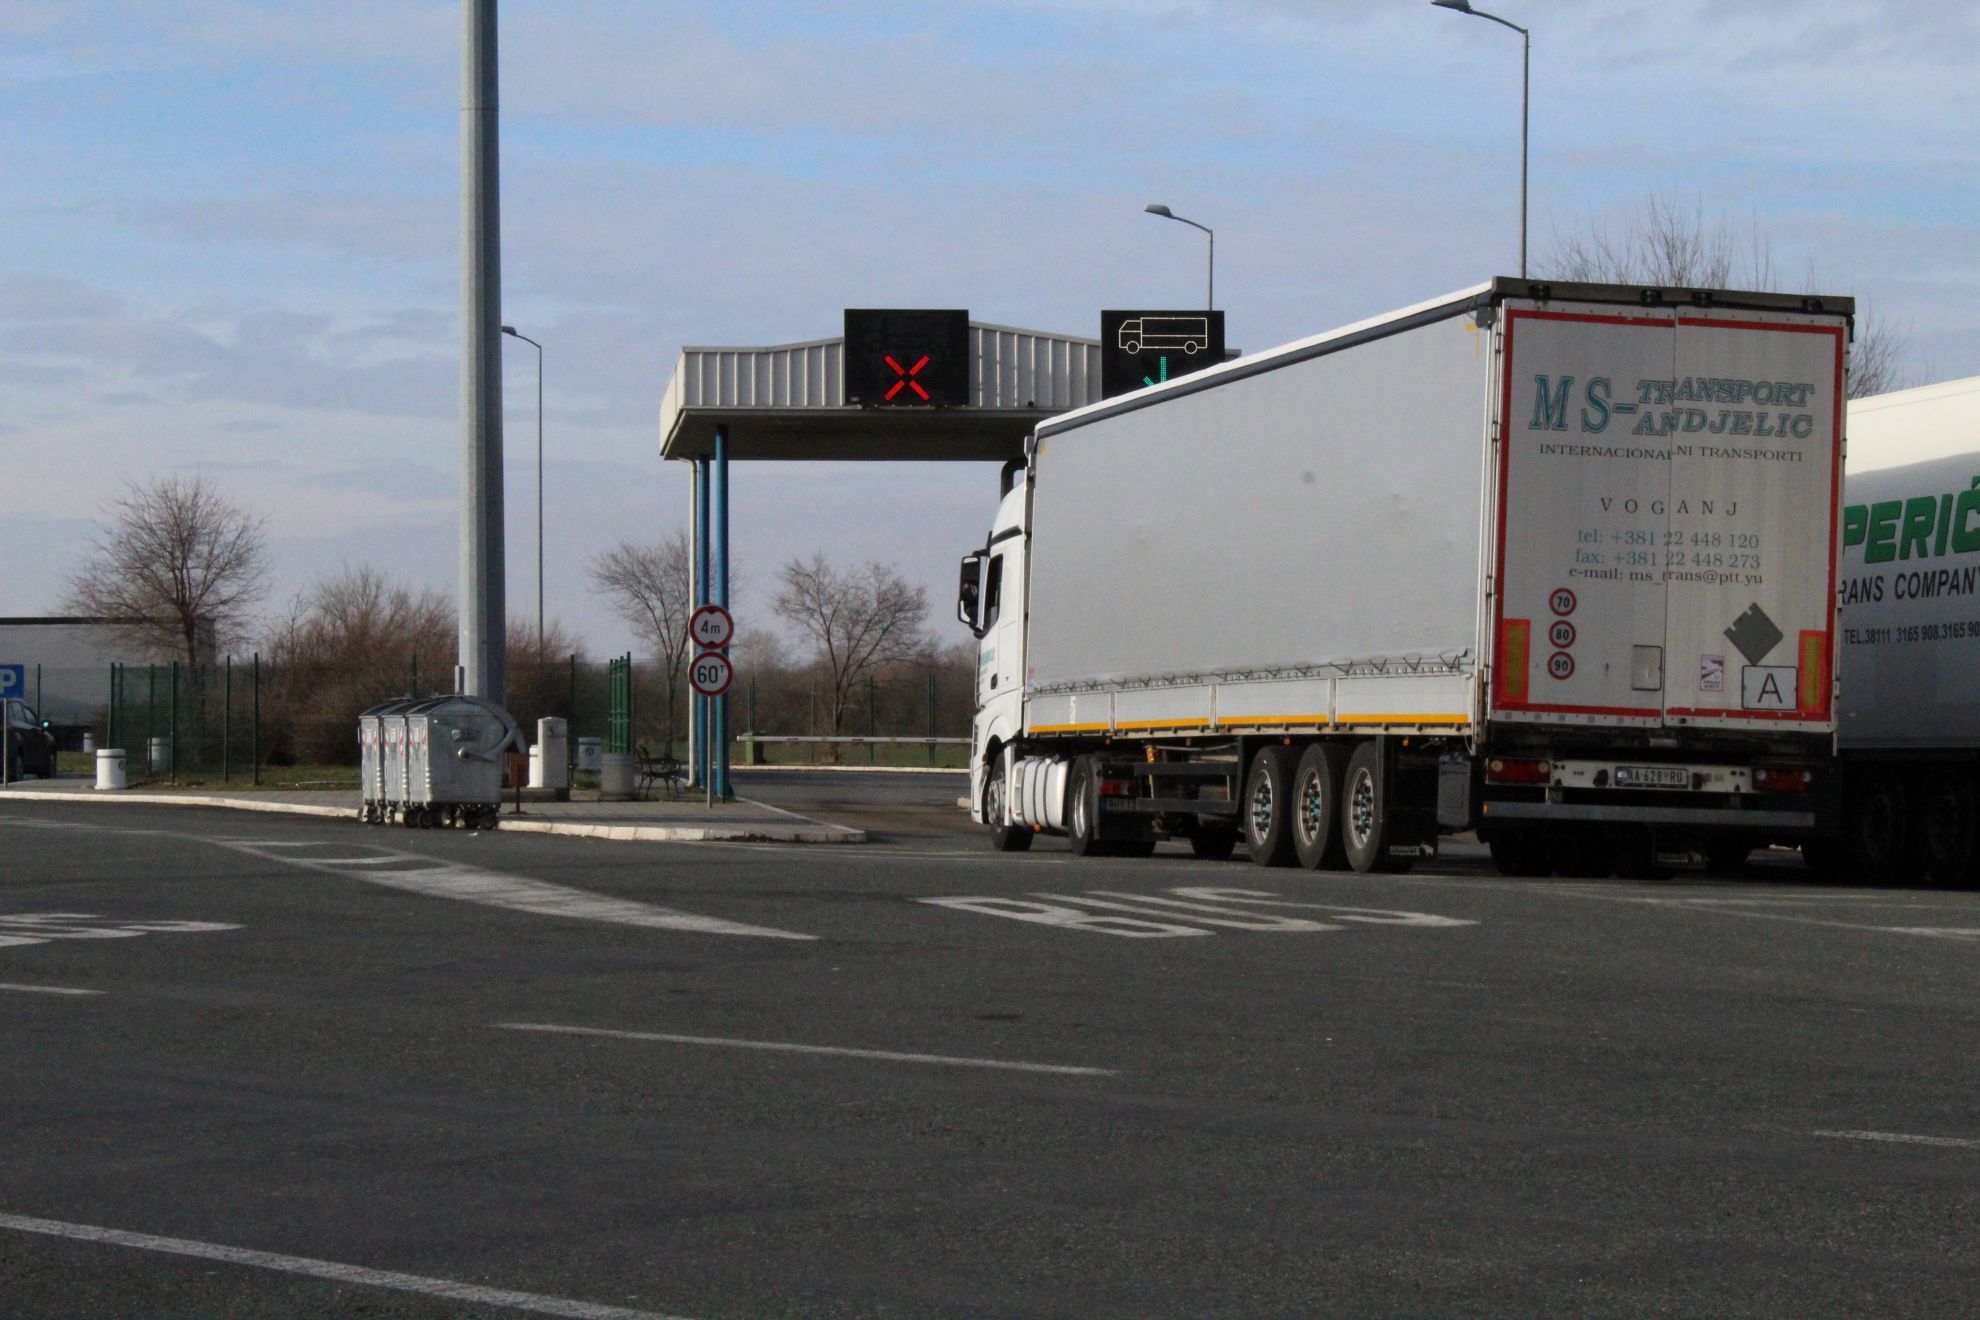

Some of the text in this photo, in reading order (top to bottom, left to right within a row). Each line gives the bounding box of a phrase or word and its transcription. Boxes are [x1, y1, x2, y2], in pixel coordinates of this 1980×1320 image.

[1636, 376, 1816, 407] TRANSPORT
[1632, 407, 1814, 439] ANDJELIC
[1699, 446, 1803, 462] TRANSPORTI
[1577, 529, 1760, 549] tel: +381 22 448 120
[1575, 548, 1761, 569] fax: +381 22 448 273
[1569, 567, 1623, 580] e-mail:
[1894, 565, 1980, 600] COMPAN
[1557, 596, 1570, 608] 70
[1556, 628, 1570, 641] 80
[1896, 626, 1919, 643] 3165
[1554, 659, 1569, 672] 90
[0, 668, 17, 694] P
[1757, 672, 1784, 704] A
